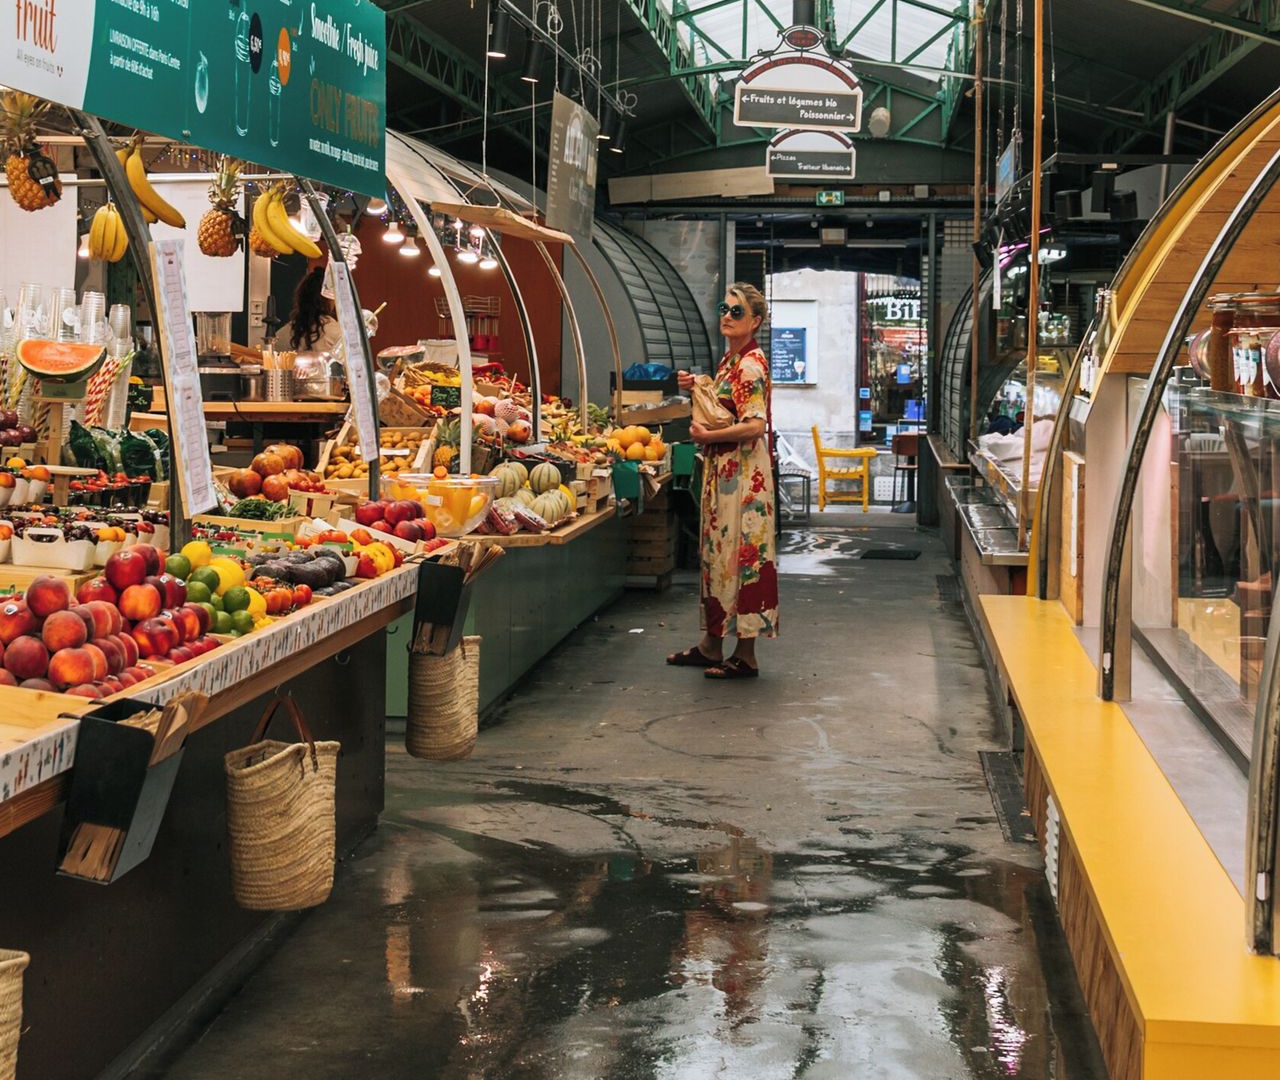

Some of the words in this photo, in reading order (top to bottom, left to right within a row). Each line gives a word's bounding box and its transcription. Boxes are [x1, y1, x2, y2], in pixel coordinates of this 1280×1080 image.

[750, 93, 775, 105] Fruits
[776, 95, 787, 105] et
[825, 98, 838, 108] bio
[799, 109, 846, 121] Poissonnier
